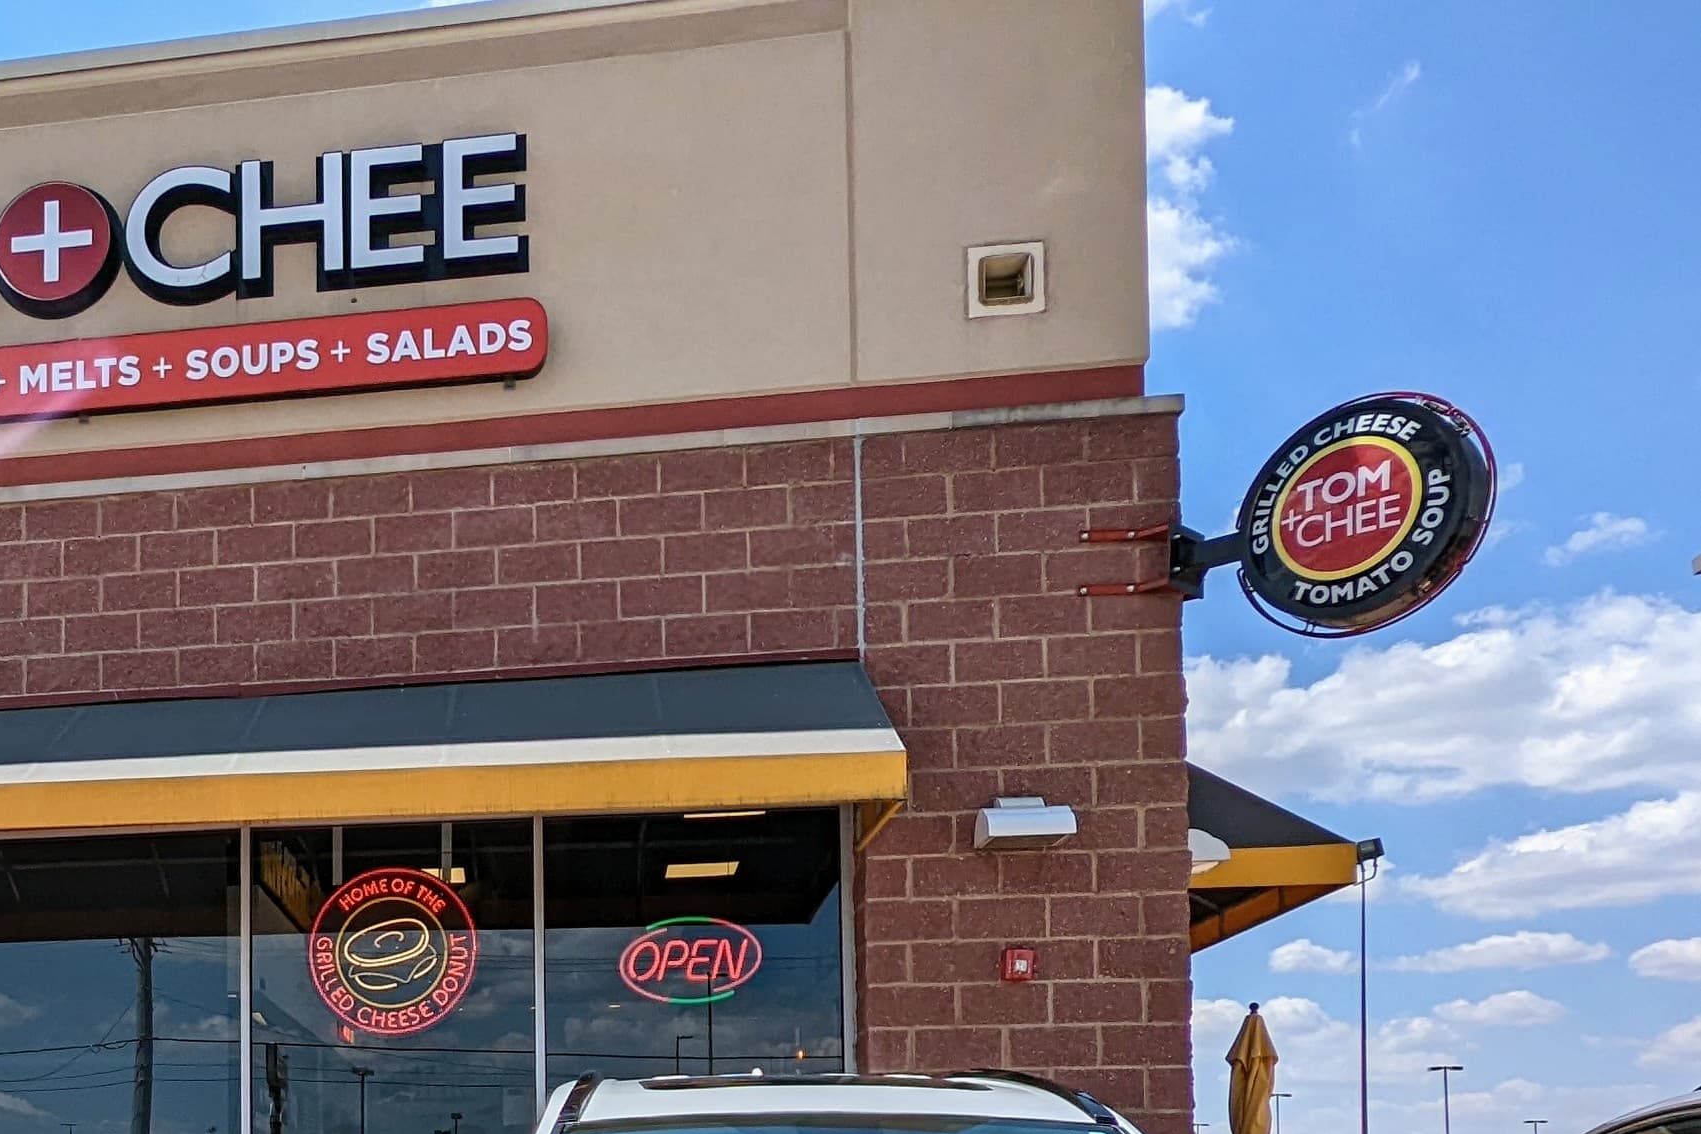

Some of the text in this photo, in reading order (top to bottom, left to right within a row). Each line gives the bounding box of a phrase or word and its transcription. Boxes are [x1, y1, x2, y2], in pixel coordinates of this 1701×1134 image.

[19, 355, 141, 396] MELTS
[185, 339, 320, 381] SOUPS
[366, 319, 534, 365] SALADS
[1252, 413, 1422, 555] GRILLED CHEESE
[1296, 459, 1393, 512] TOM
[1294, 468, 1451, 604] TOMATO SOUP
[338, 878, 447, 913] HOME OF THE
[316, 933, 469, 1028] GRILLED CHEESE DONUT
[627, 938, 749, 982] OPEN
